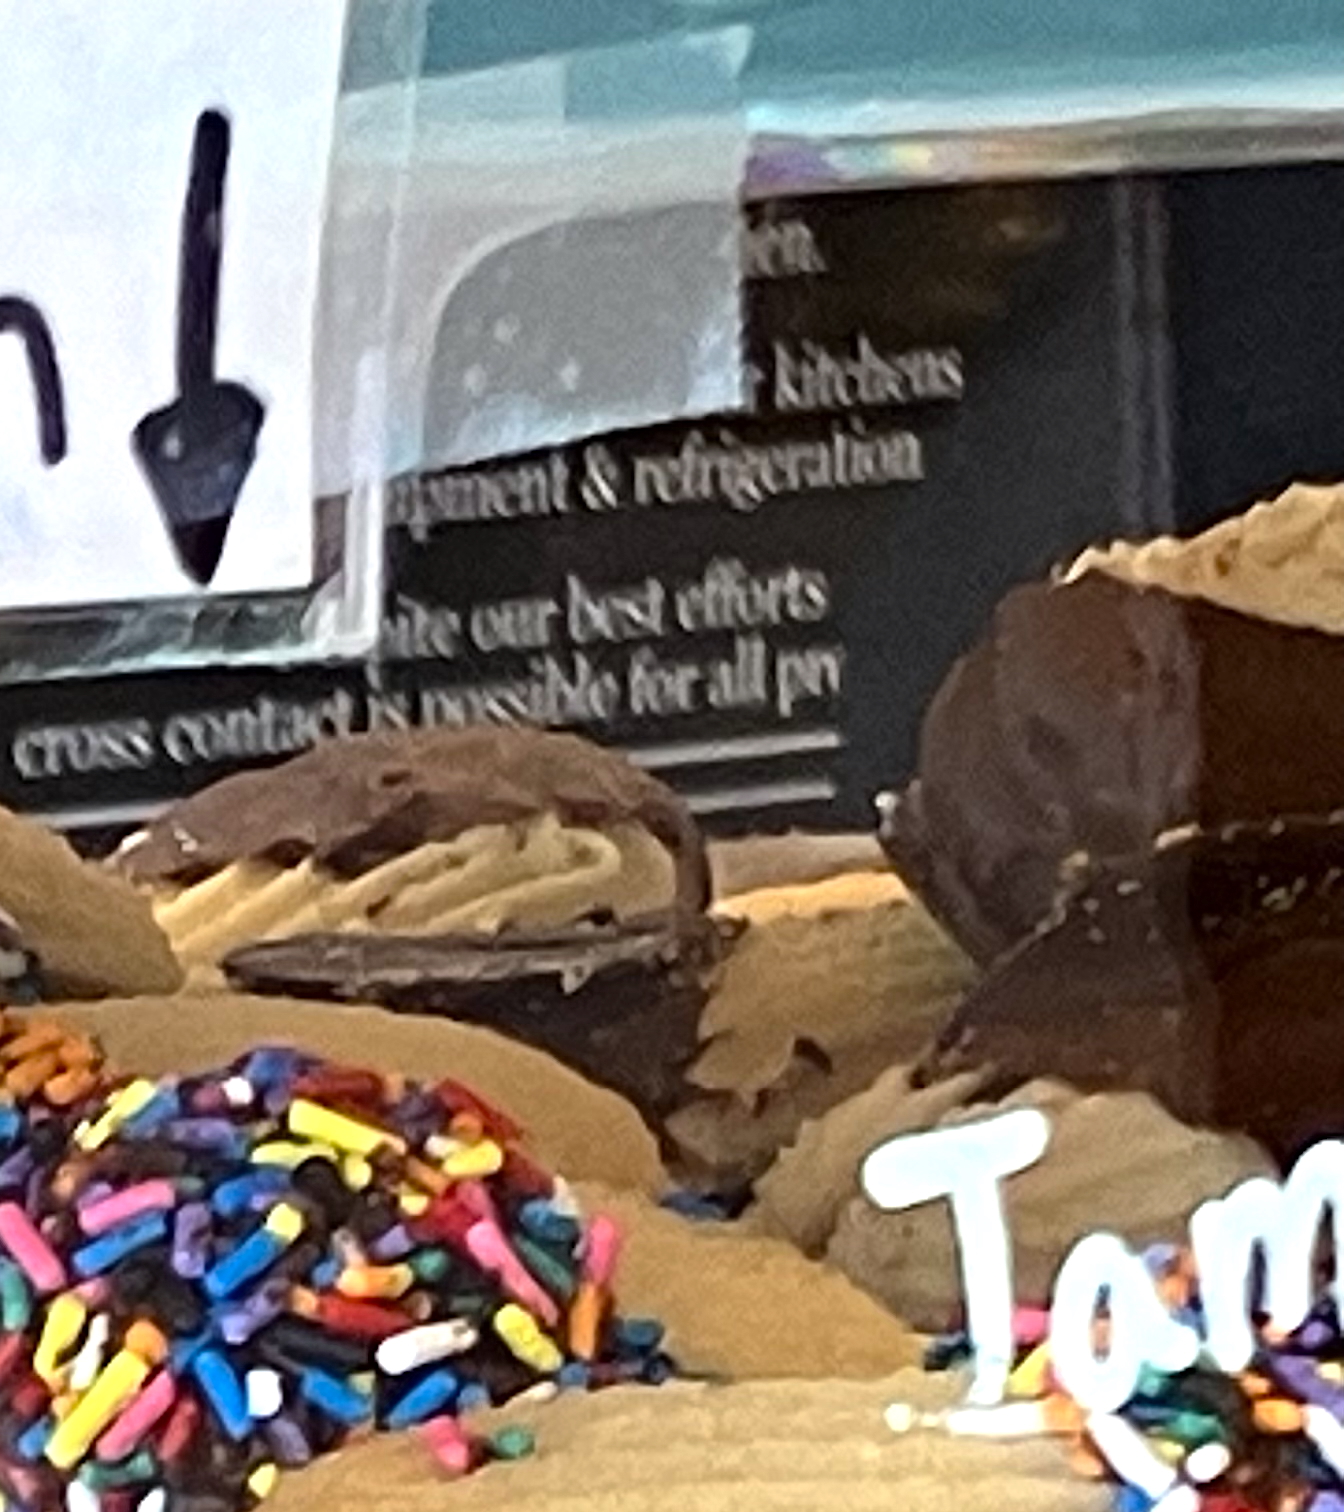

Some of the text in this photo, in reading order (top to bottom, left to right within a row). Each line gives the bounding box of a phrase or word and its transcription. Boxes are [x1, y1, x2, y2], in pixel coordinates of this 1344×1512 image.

[773, 330, 965, 410] kitchens
[580, 443, 618, 512] &
[632, 410, 926, 512] refrigeration
[469, 598, 562, 653] our
[566, 572, 666, 646] best
[676, 556, 828, 632] efforts
[12, 716, 154, 780] cross
[161, 690, 352, 764] contact
[630, 644, 702, 718] for
[708, 630, 767, 708] all
